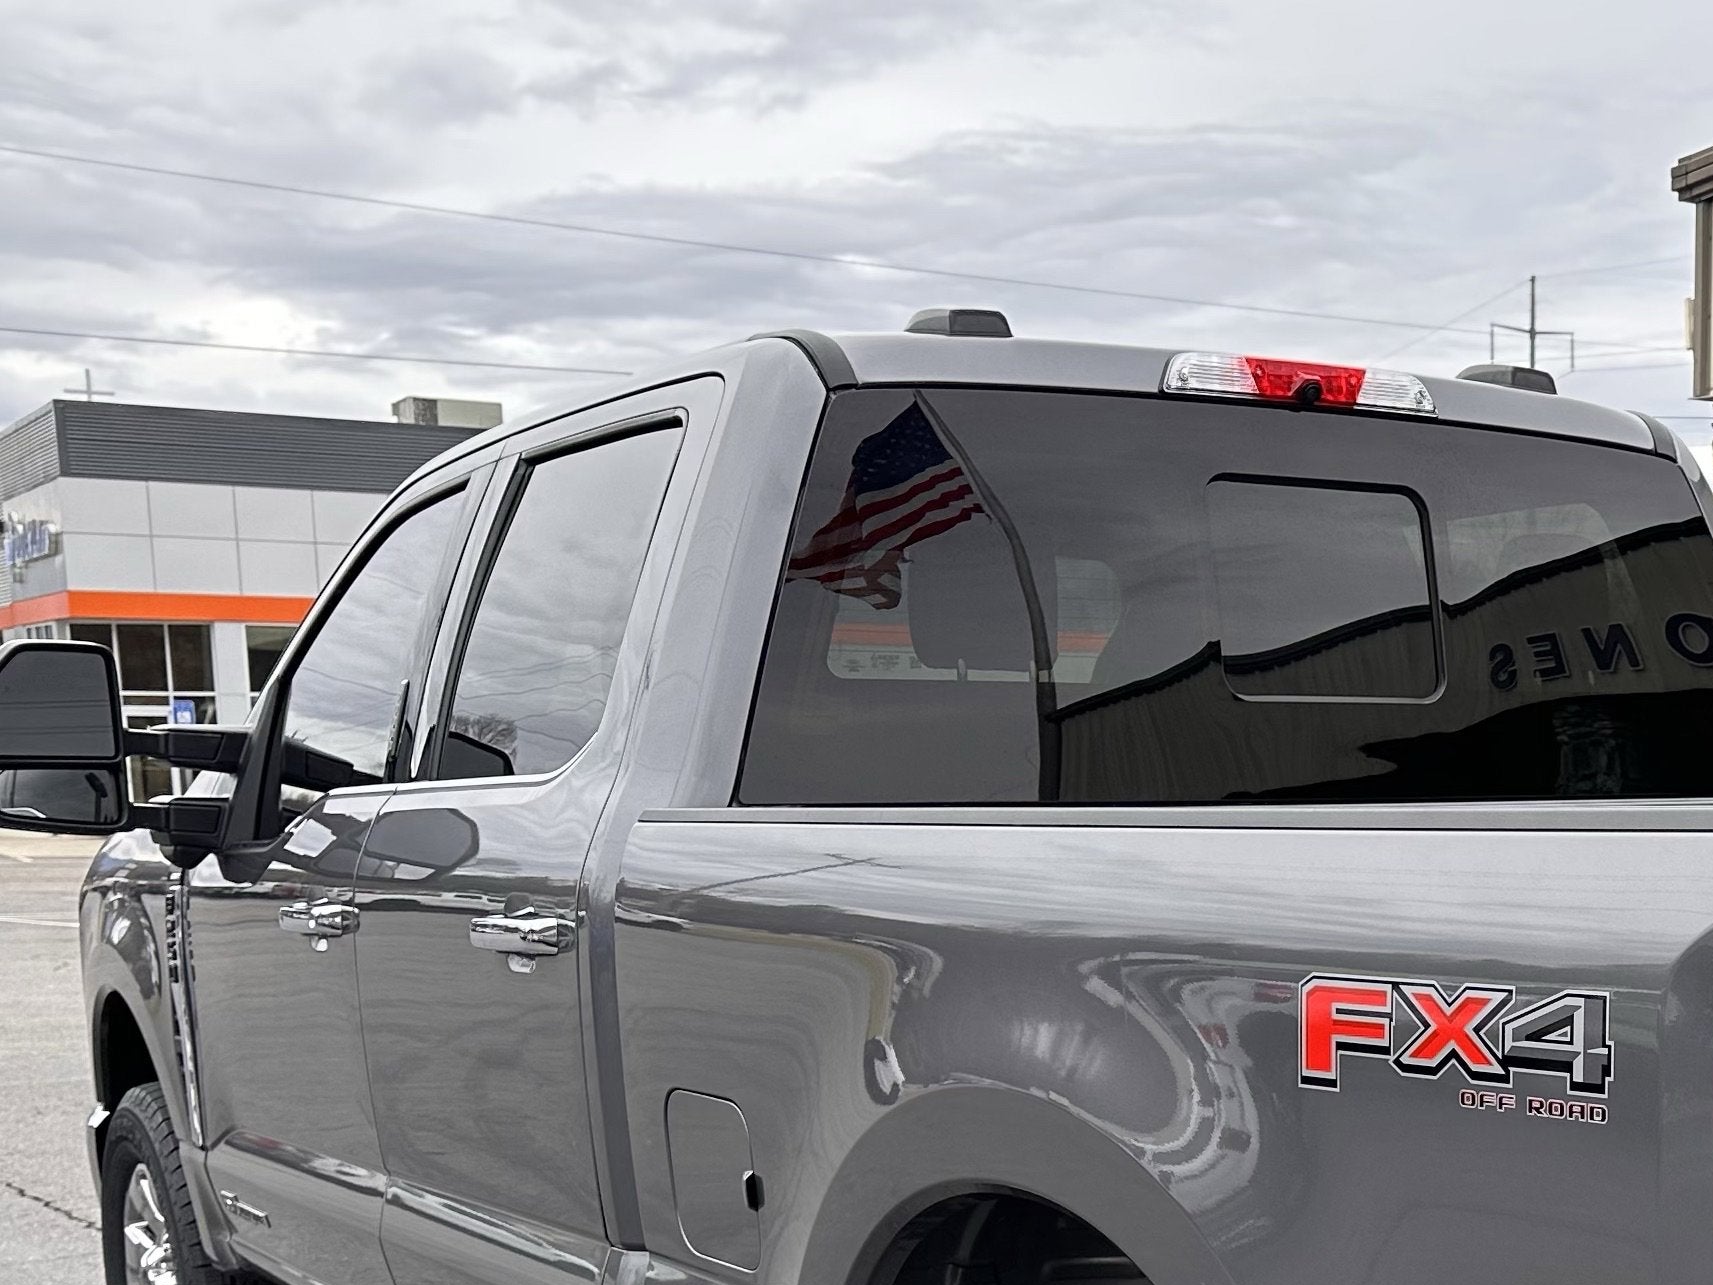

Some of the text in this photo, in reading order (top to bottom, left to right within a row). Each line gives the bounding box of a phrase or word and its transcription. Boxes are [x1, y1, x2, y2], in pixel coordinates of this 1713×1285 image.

[1298, 972, 1614, 1098] FX4
[1459, 1089, 1609, 1124] OFF ROAD
